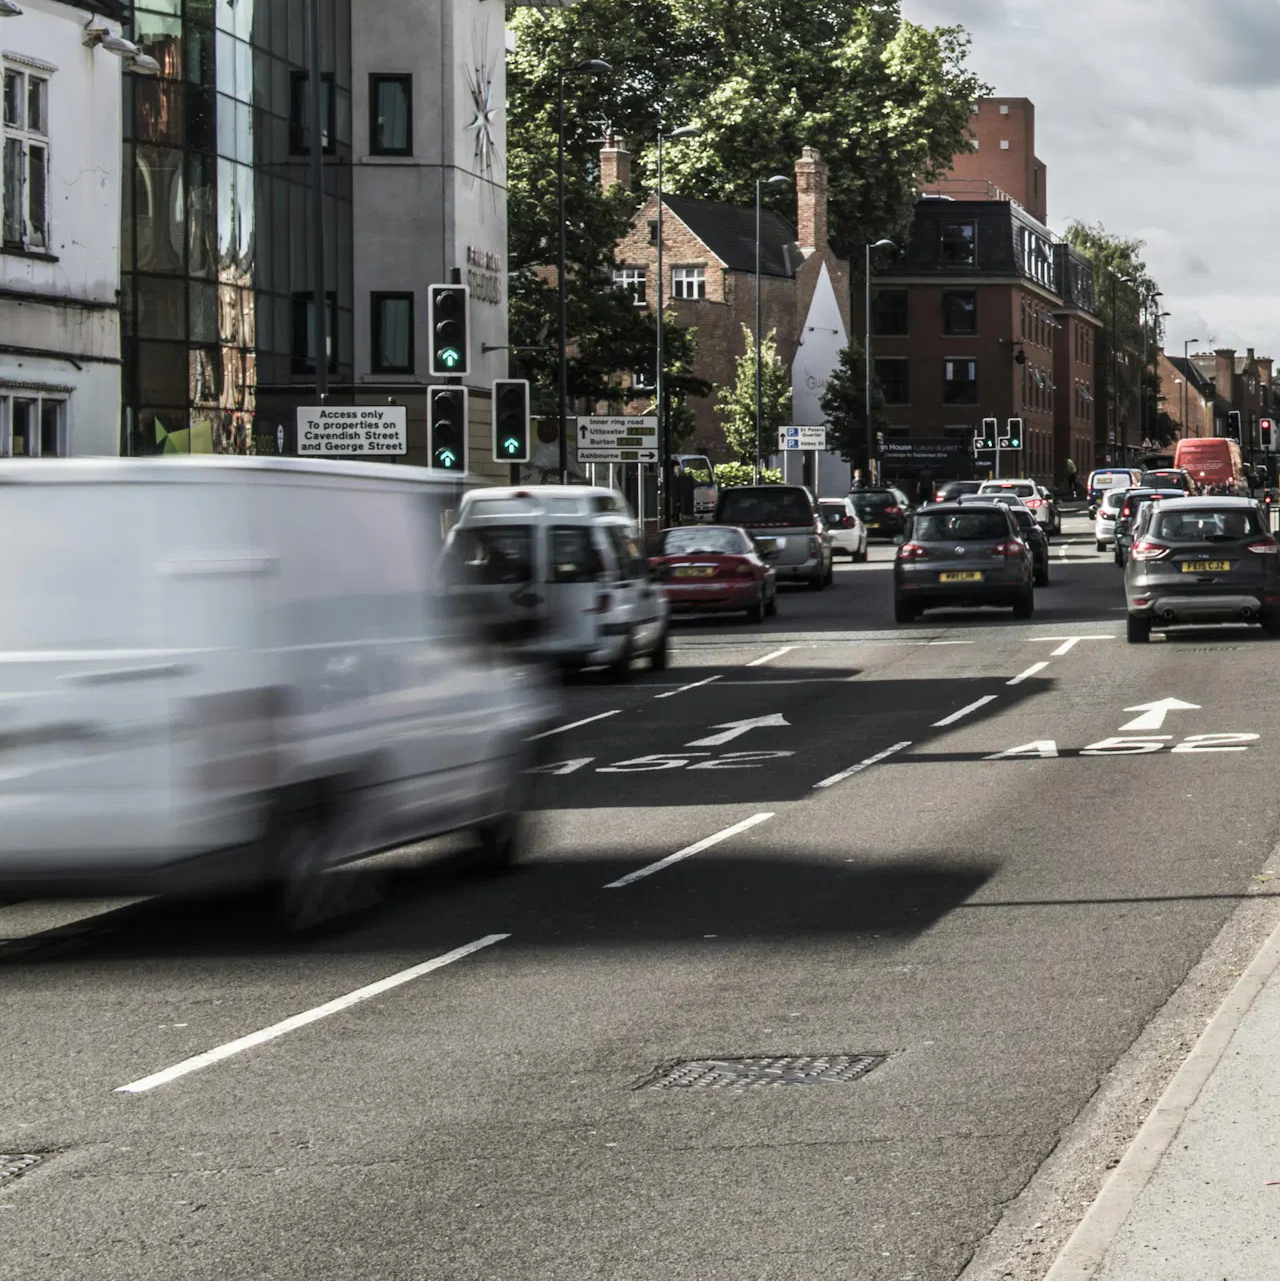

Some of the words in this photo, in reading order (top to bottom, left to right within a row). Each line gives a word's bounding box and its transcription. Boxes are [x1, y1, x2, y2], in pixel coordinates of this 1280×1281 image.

[320, 410, 358, 419] Access
[360, 410, 384, 420] only
[307, 420, 320, 429] To
[323, 420, 380, 431] properties
[304, 431, 361, 440] Cavendish
[364, 431, 400, 440] Street
[301, 442, 321, 451] and
[324, 441, 364, 452] George
[367, 441, 404, 451] Street
[982, 733, 1260, 760] A52
[520, 751, 797, 775] A52
